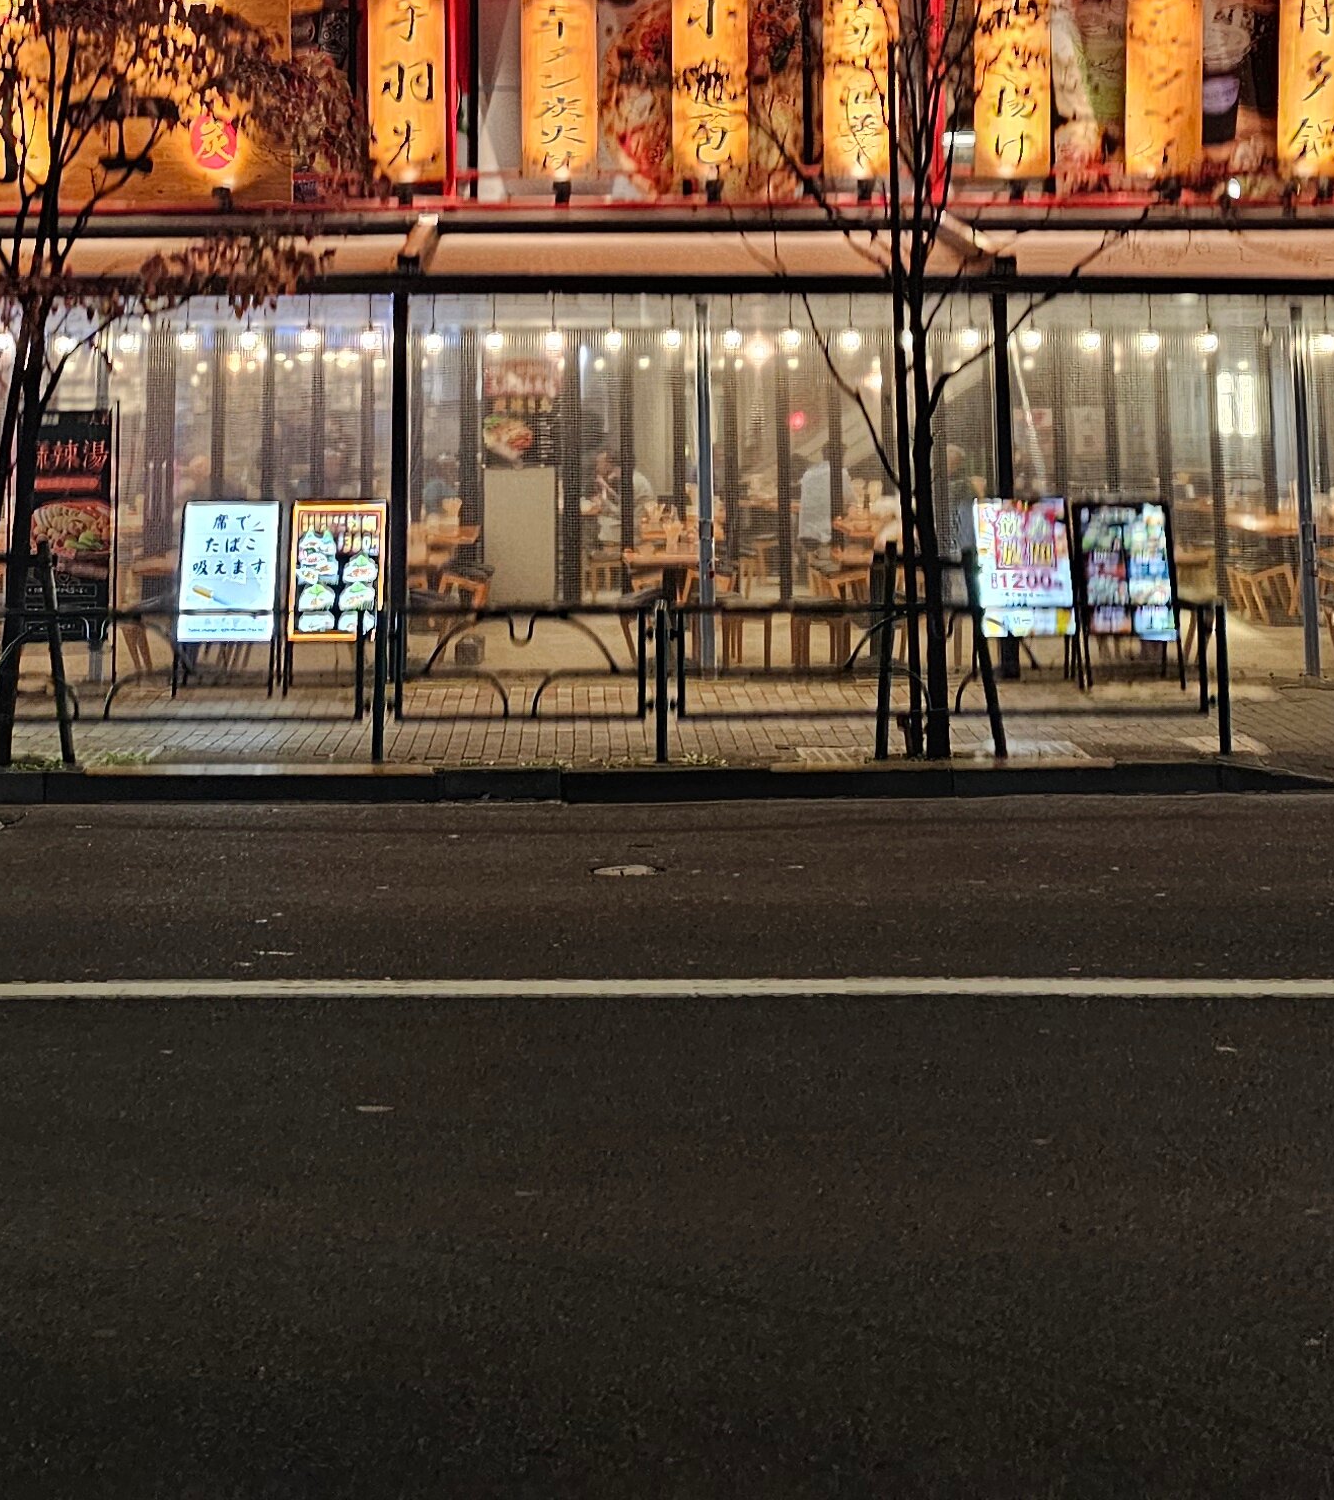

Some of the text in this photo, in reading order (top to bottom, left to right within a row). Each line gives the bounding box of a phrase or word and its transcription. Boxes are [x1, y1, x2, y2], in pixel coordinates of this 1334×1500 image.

[213, 514, 251, 531] 席で
[205, 537, 256, 553] たばこ
[192, 558, 265, 576] 吸えます
